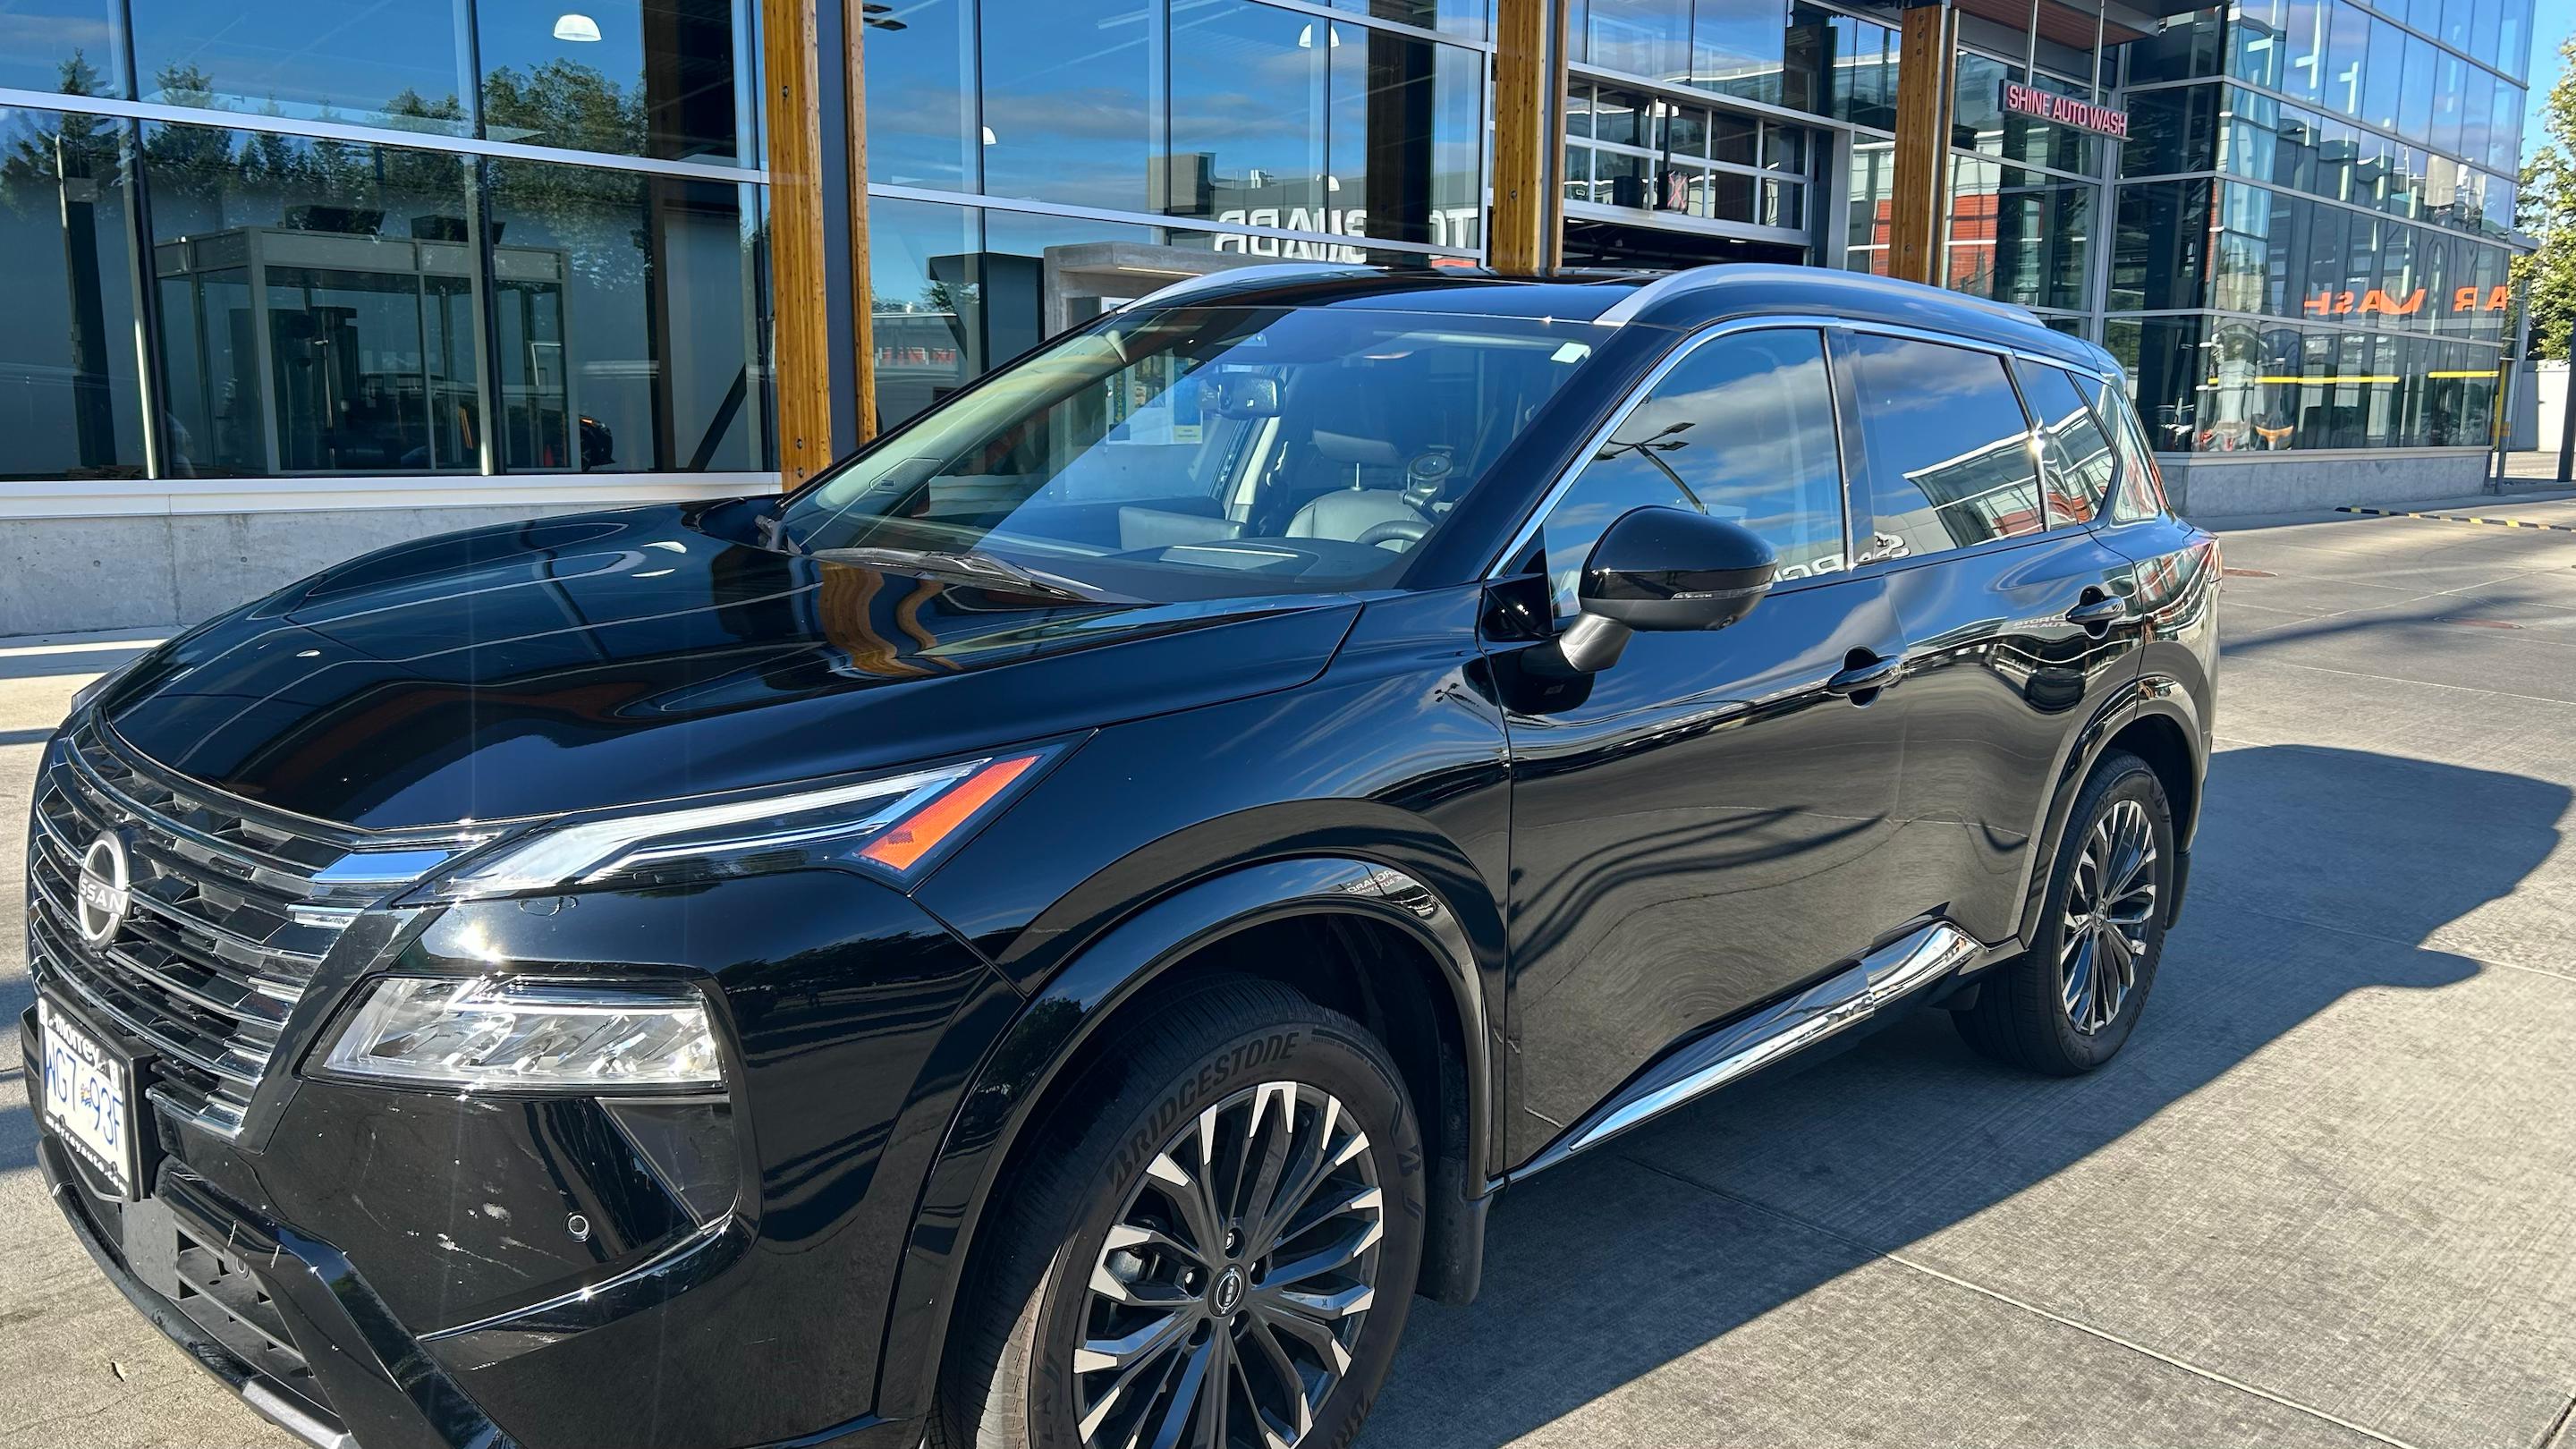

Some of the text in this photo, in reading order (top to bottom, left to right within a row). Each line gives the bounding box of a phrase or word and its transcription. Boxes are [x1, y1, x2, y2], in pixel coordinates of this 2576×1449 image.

[2009, 85, 2127, 136] SHINE AUTO WASH
[1107, 1031, 1300, 1196] BRIDGESTONE
